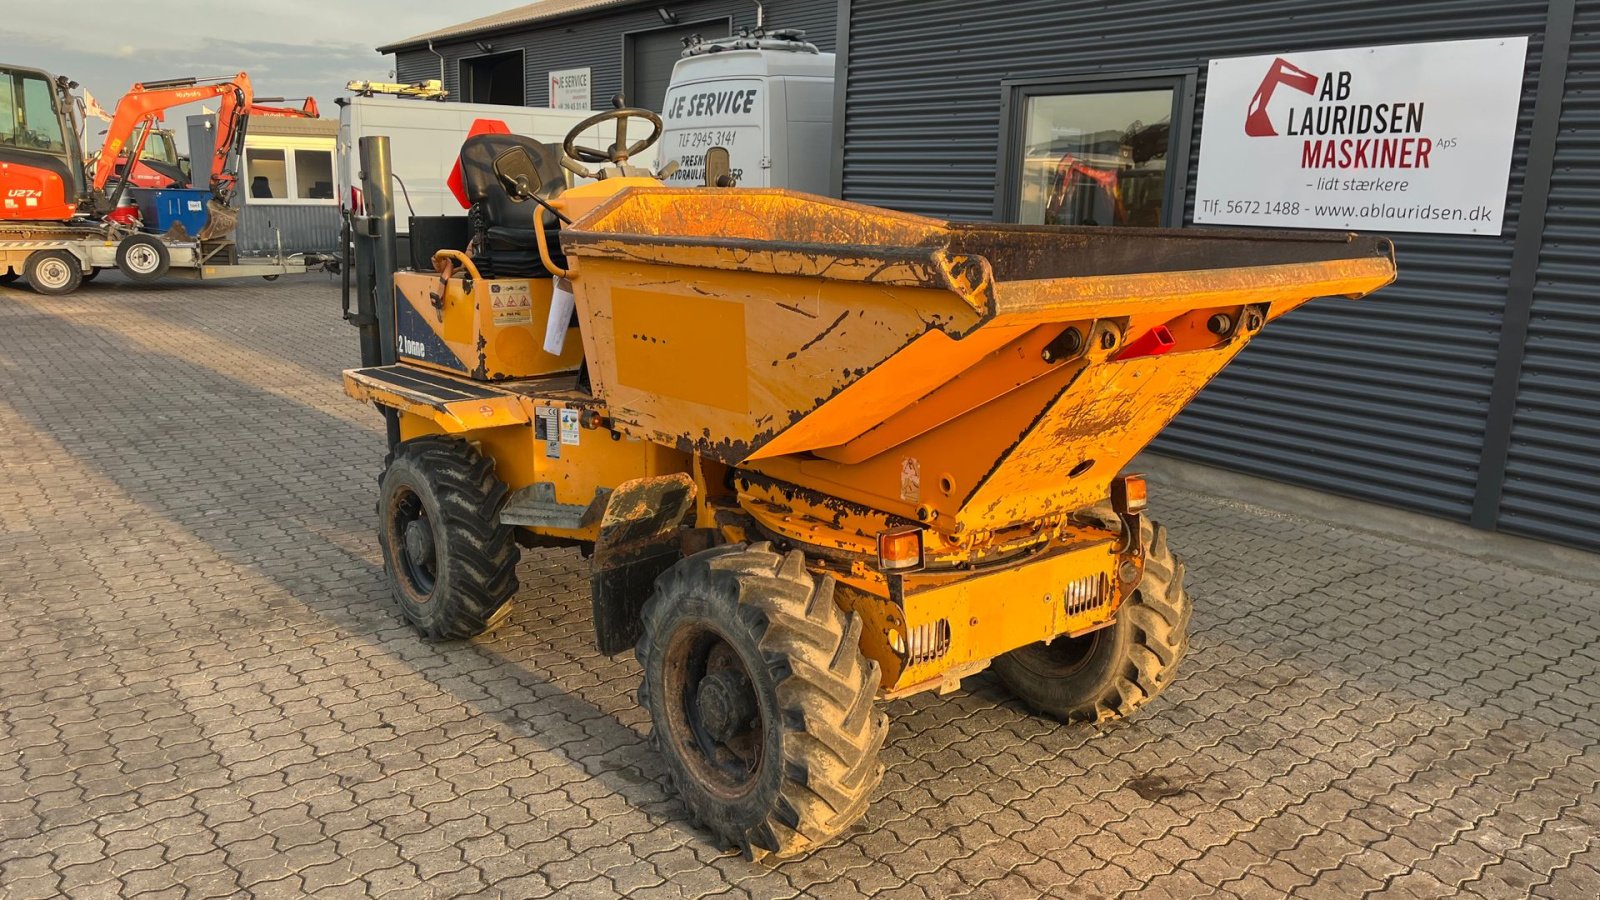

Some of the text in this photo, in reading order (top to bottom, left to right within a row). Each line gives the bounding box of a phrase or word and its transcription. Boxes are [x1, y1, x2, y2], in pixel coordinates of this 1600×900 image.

[565, 74, 587, 88] SERVICE
[1320, 71, 1352, 101] AB
[669, 89, 758, 119] JE SERVICE
[1287, 102, 1425, 135] LAURIDSEN
[679, 130, 737, 148] TLF 2945 3141
[1301, 138, 1457, 169] MASKINER ApS
[1317, 177, 1339, 191] lidt
[1342, 177, 1409, 192] stærkere
[1203, 199, 1222, 216] Tlf.
[1226, 200, 1260, 215] 5672
[1264, 201, 1300, 216] 1488
[1315, 202, 1492, 222] www.ablauridsen.dk
[398, 334, 425, 358] 2 tonne
